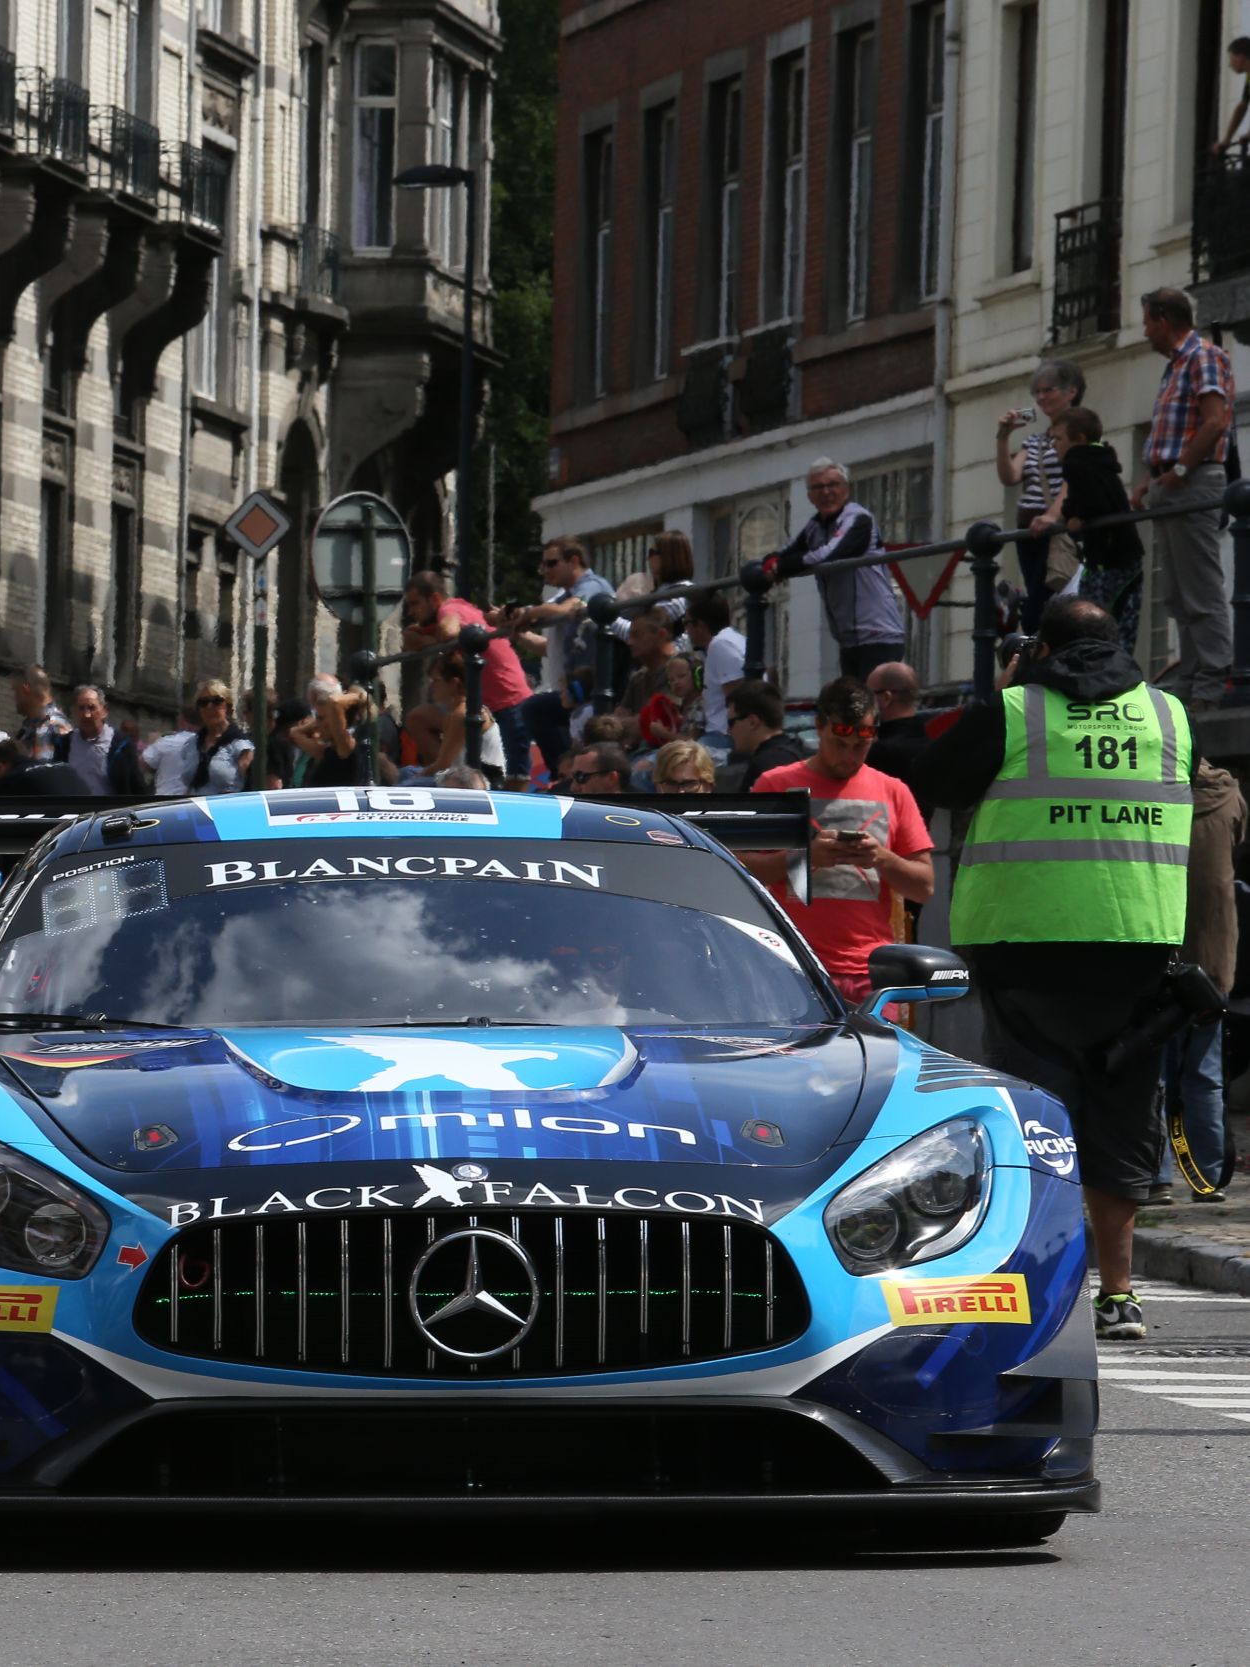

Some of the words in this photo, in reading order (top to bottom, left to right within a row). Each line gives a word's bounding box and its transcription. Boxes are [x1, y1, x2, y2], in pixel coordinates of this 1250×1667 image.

[1066, 702, 1145, 722] SRO
[1075, 735, 1138, 770] 181
[334, 790, 437, 811] 18
[1050, 805, 1091, 824] PIT
[1101, 805, 1163, 826] LANE
[52, 855, 135, 882] POSITION
[203, 856, 605, 889] BLANCPAIN
[1023, 1136, 1078, 1155] FUCHS
[166, 1184, 406, 1230] BLACK
[480, 1181, 768, 1226] FALCON
[897, 1282, 1018, 1316] PIRELLI
